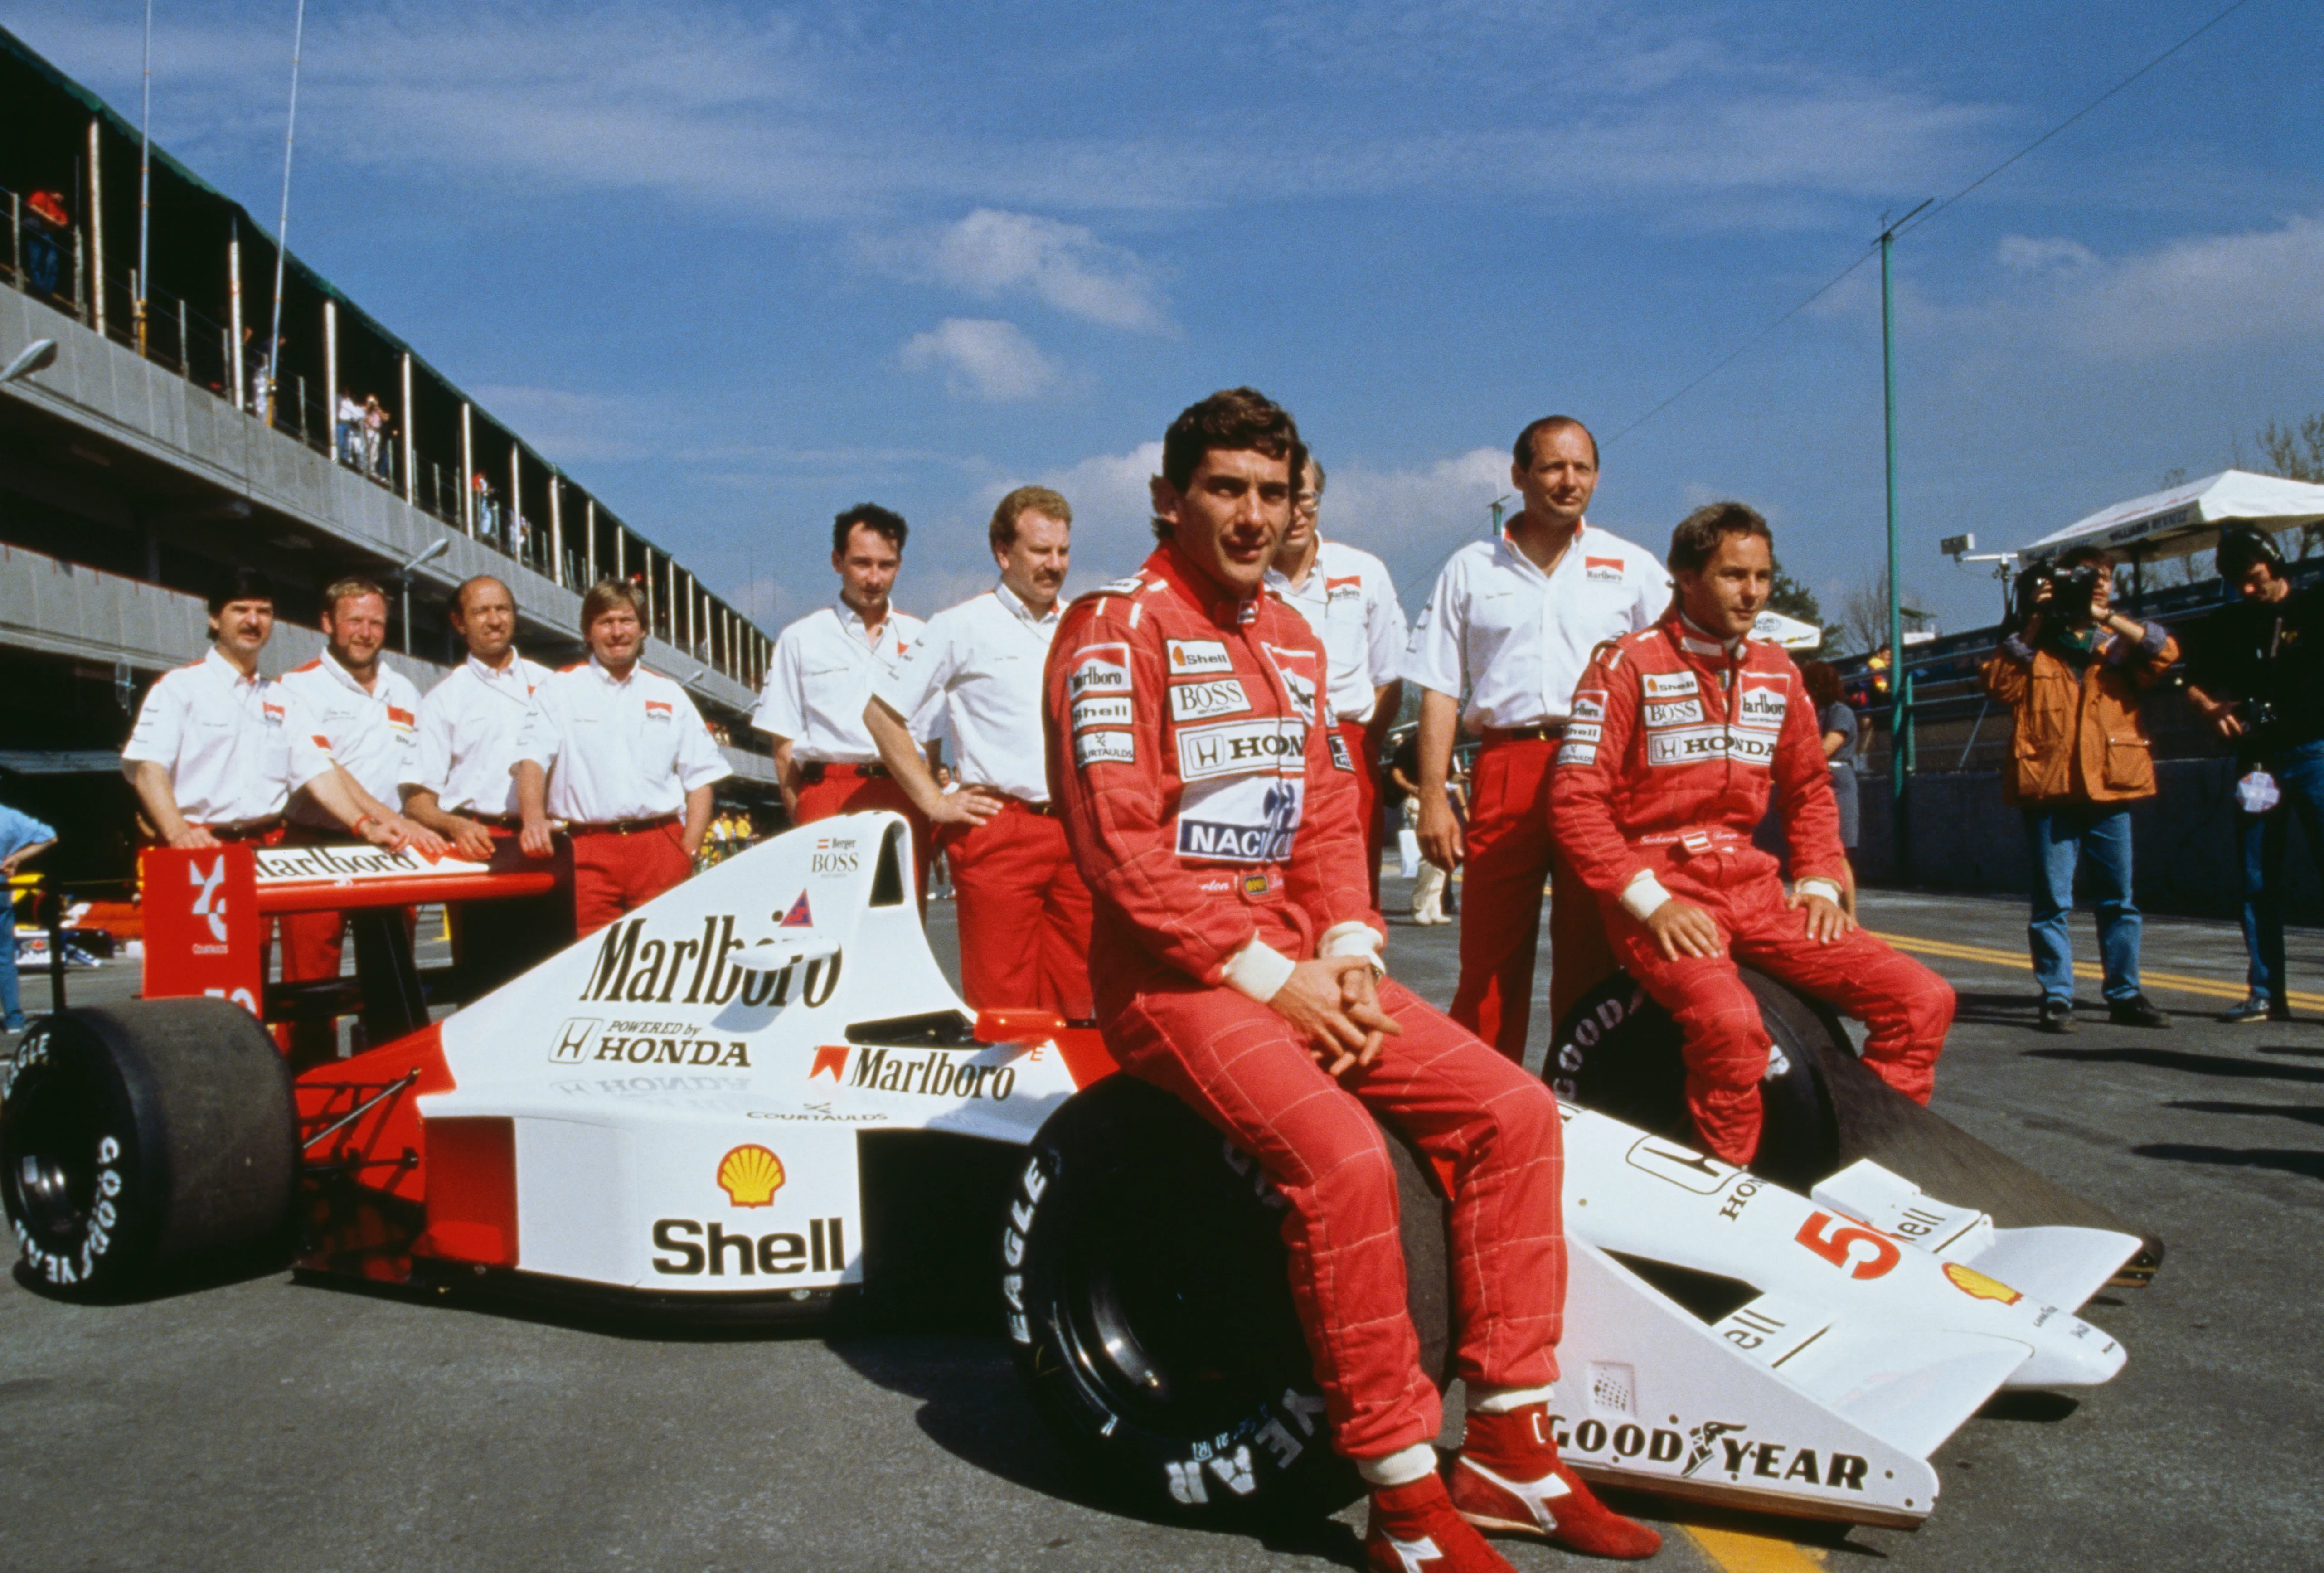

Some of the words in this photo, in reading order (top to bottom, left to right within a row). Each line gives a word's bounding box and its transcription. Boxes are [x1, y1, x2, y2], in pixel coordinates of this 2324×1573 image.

[1587, 569, 1623, 582] Marlboro
[1328, 587, 1360, 599] Marlboro
[1186, 653, 1227, 665] Shell
[1179, 682, 1242, 711] BOSS
[1659, 680, 1695, 691] Shell
[1650, 701, 1698, 721] BOSS
[1228, 735, 1304, 761] HON
[1683, 734, 1776, 757] HONDA
[832, 838, 856, 850] Berger
[812, 853, 859, 873] BOSS
[579, 915, 843, 1008] Marlboro
[606, 1020, 682, 1035] POWERED
[684, 1022, 702, 1039] by
[594, 1037, 752, 1067] HONDA
[848, 1047, 1016, 1101] Marlboro
[747, 1111, 888, 1122] COURTAULDS
[1718, 1179, 1769, 1222] HON
[653, 1217, 845, 1276] Shell
[1003, 1157, 1047, 1344] EAGLE
[1794, 1210, 1901, 1281] 5
[1724, 1308, 1786, 1350] ell
[1550, 1414, 1684, 1463] GOOD
[1721, 1437, 1868, 1491] YEAR
